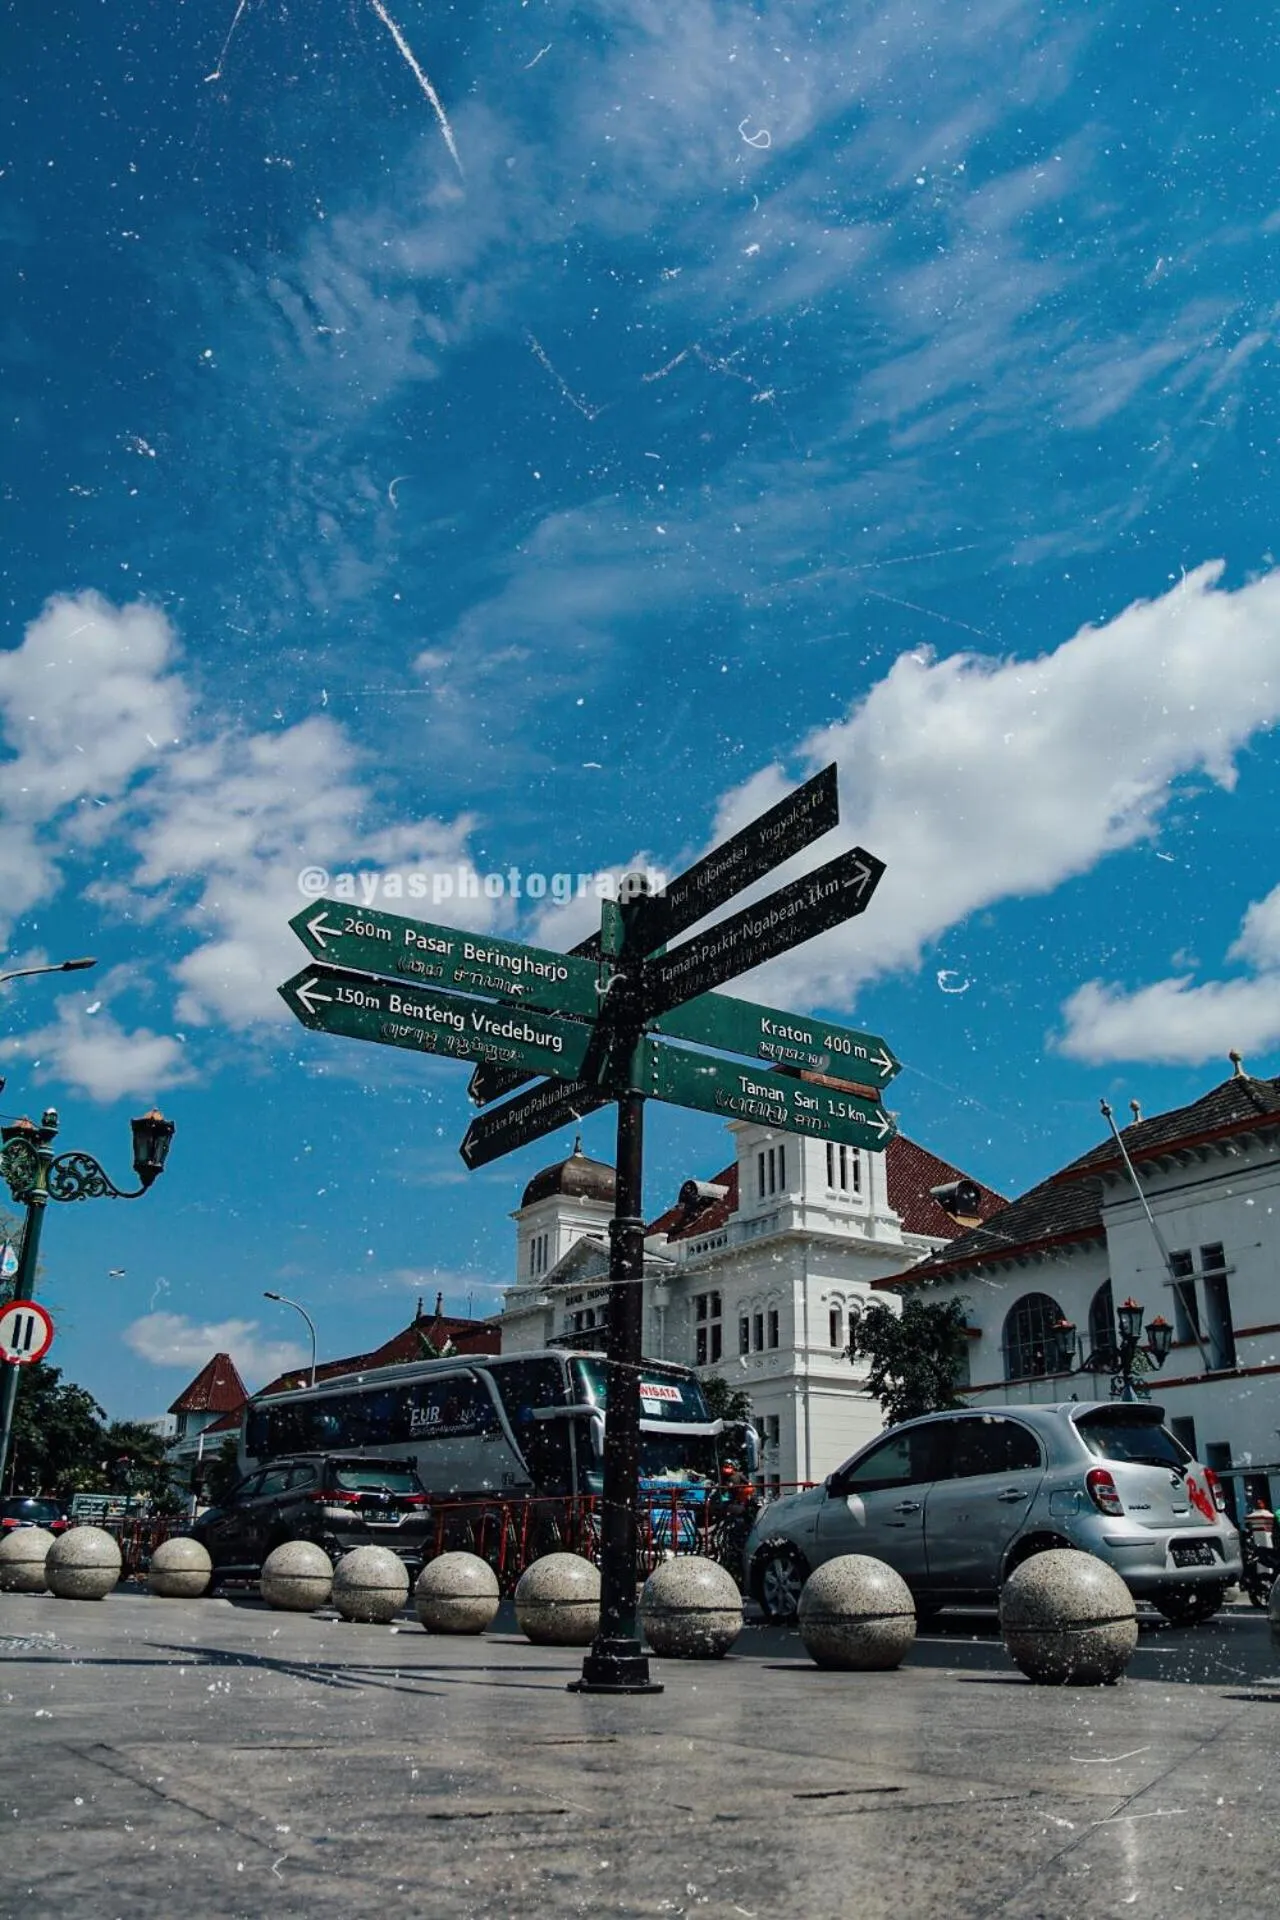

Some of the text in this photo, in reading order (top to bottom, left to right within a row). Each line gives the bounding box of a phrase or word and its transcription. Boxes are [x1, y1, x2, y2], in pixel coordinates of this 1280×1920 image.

[344, 918, 392, 942] 260m
[404, 928, 455, 955] Pasar
[463, 942, 569, 982] Beringharjo
[660, 955, 699, 983] Taman
[702, 930, 738, 958] Parkir
[742, 898, 803, 939] Ngabean
[335, 987, 380, 1011] 150m
[389, 995, 466, 1032] Benteng
[471, 1011, 563, 1052] Vredeburg
[760, 1018, 813, 1045] Kraton
[739, 1075, 785, 1102] Taman
[794, 1091, 820, 1111] Sari
